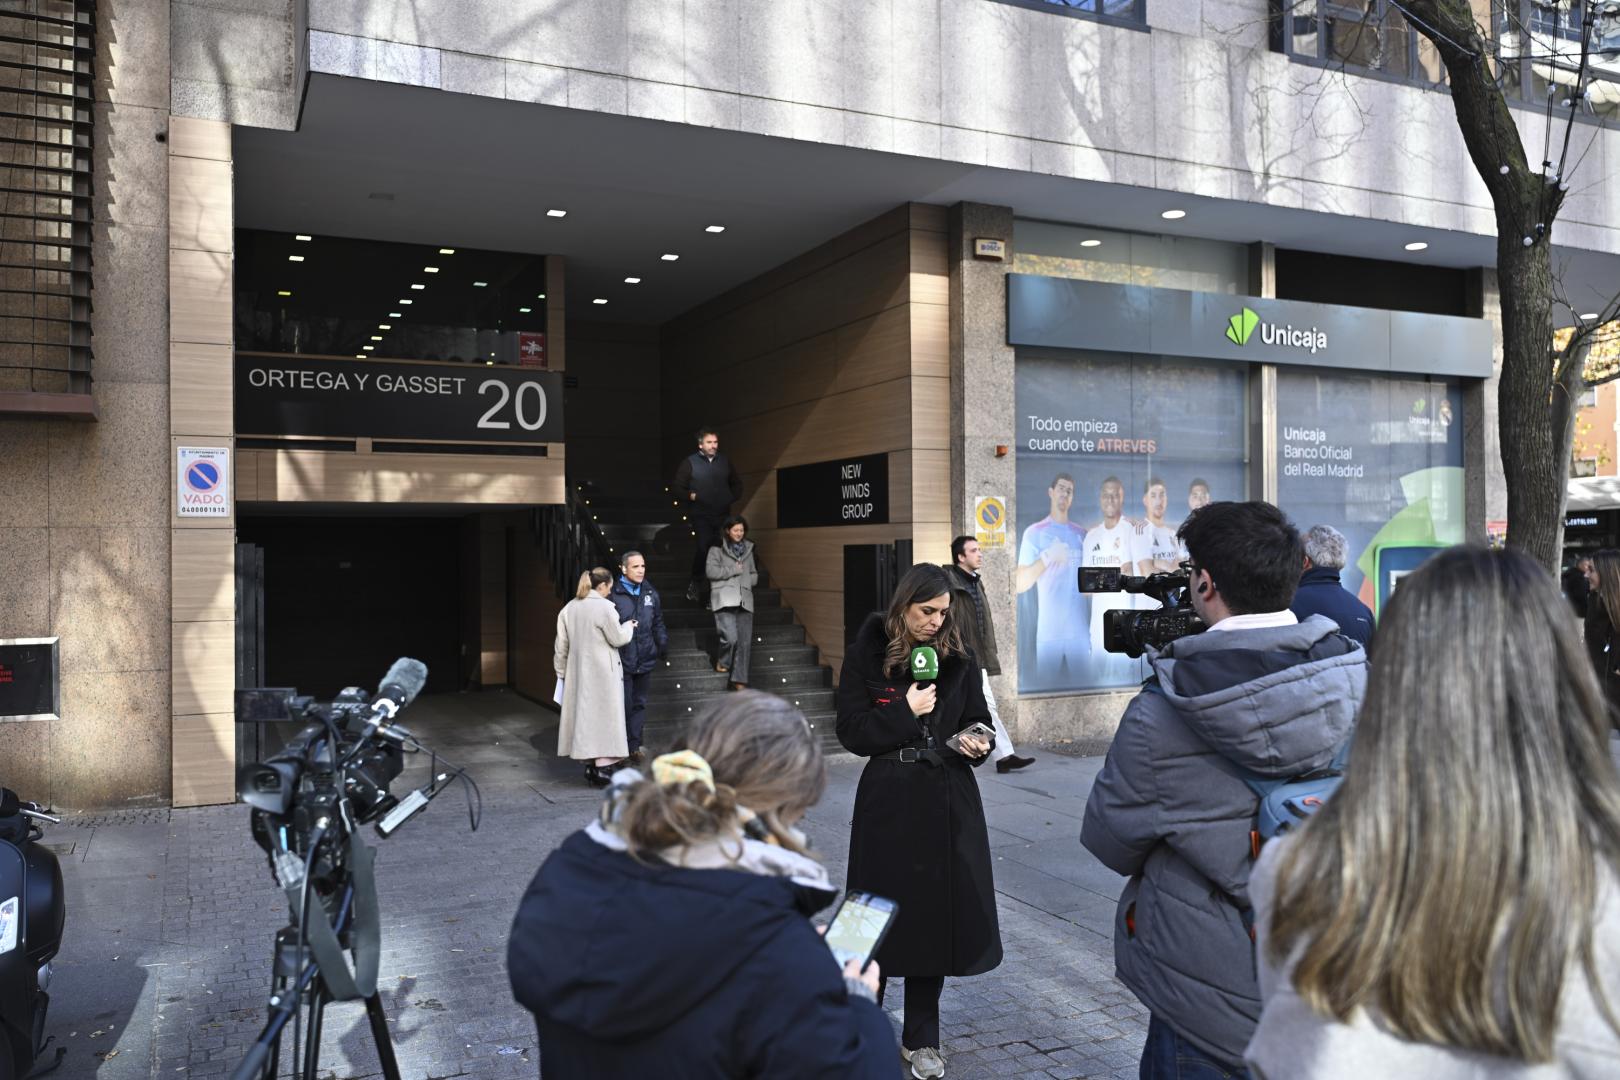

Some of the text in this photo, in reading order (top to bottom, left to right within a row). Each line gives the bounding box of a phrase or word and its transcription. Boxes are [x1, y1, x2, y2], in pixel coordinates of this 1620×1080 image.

[1262, 323, 1328, 354] Unicaja
[249, 368, 547, 430] ORTEGA Y GASSET 20
[1028, 416, 1118, 436] Todo empieza
[1284, 427, 1326, 444] Unicaja
[1028, 437, 1156, 453] cuando te ATREVES
[1284, 445, 1352, 460] Banco Oficial
[842, 464, 862, 480] NEW
[1284, 463, 1364, 478] del Real Madrid
[842, 482, 870, 499] WINDS
[183, 494, 224, 504] VADO
[842, 503, 874, 519] GROUP
